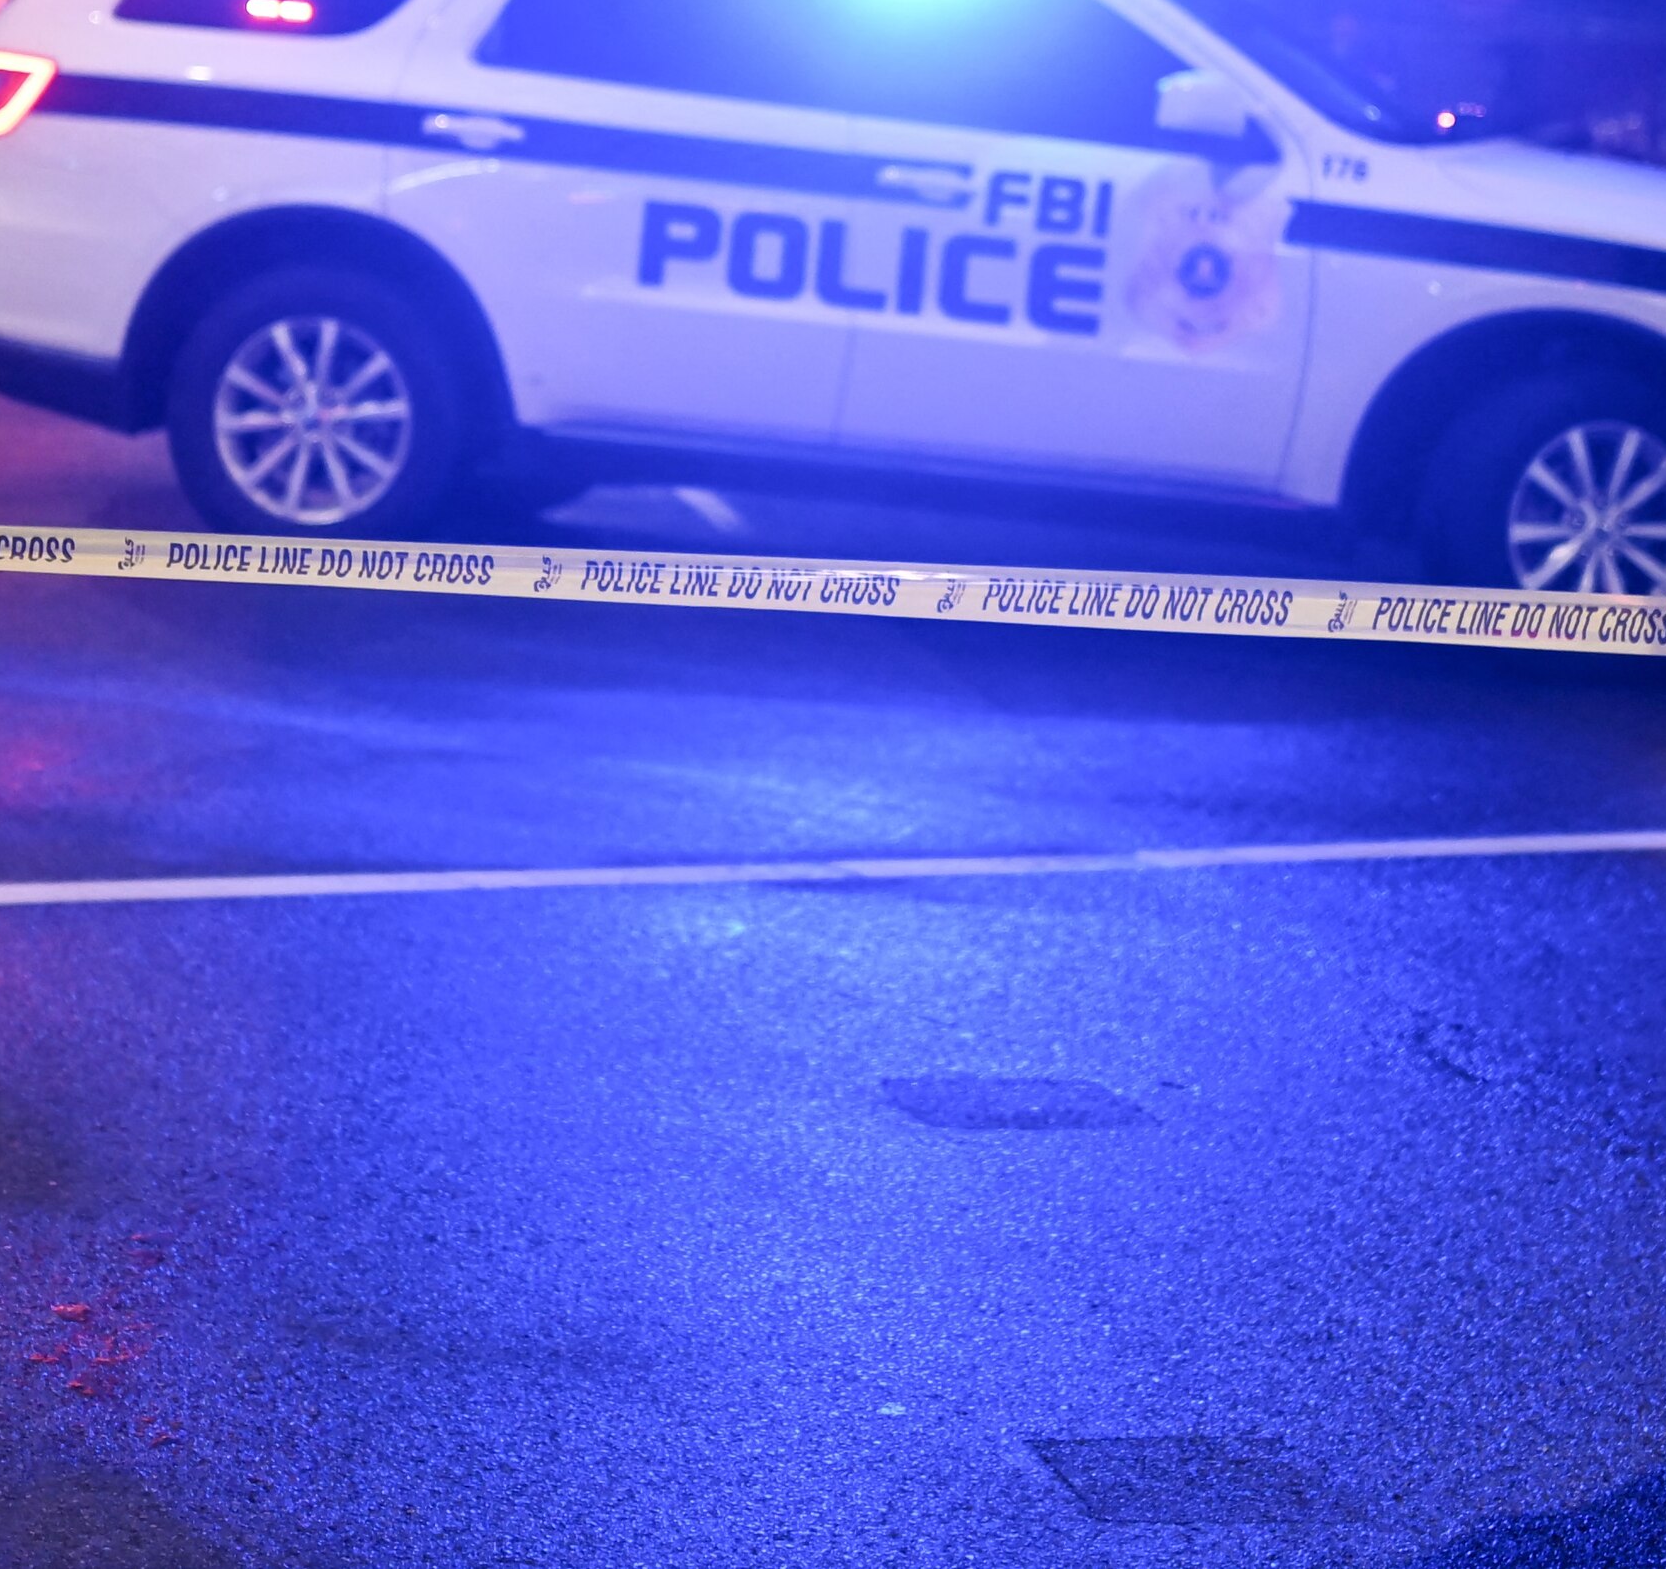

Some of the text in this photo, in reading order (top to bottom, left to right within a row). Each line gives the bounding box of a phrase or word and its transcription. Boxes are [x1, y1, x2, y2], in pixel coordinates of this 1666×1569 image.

[983, 170, 1114, 238] FBI
[636, 200, 1109, 336] POLICE
[166, 543, 494, 585] POLICE LINE DO NOT CROSS
[581, 560, 900, 607] POLICE LINE DO NOT CROSS
[982, 579, 1293, 626] POLICE LINE DO NOT CROSS
[1372, 597, 1455, 633] POLICE
[1456, 600, 1510, 636] LINE
[1511, 603, 1546, 639] DO
[1548, 604, 1598, 640] NOT
